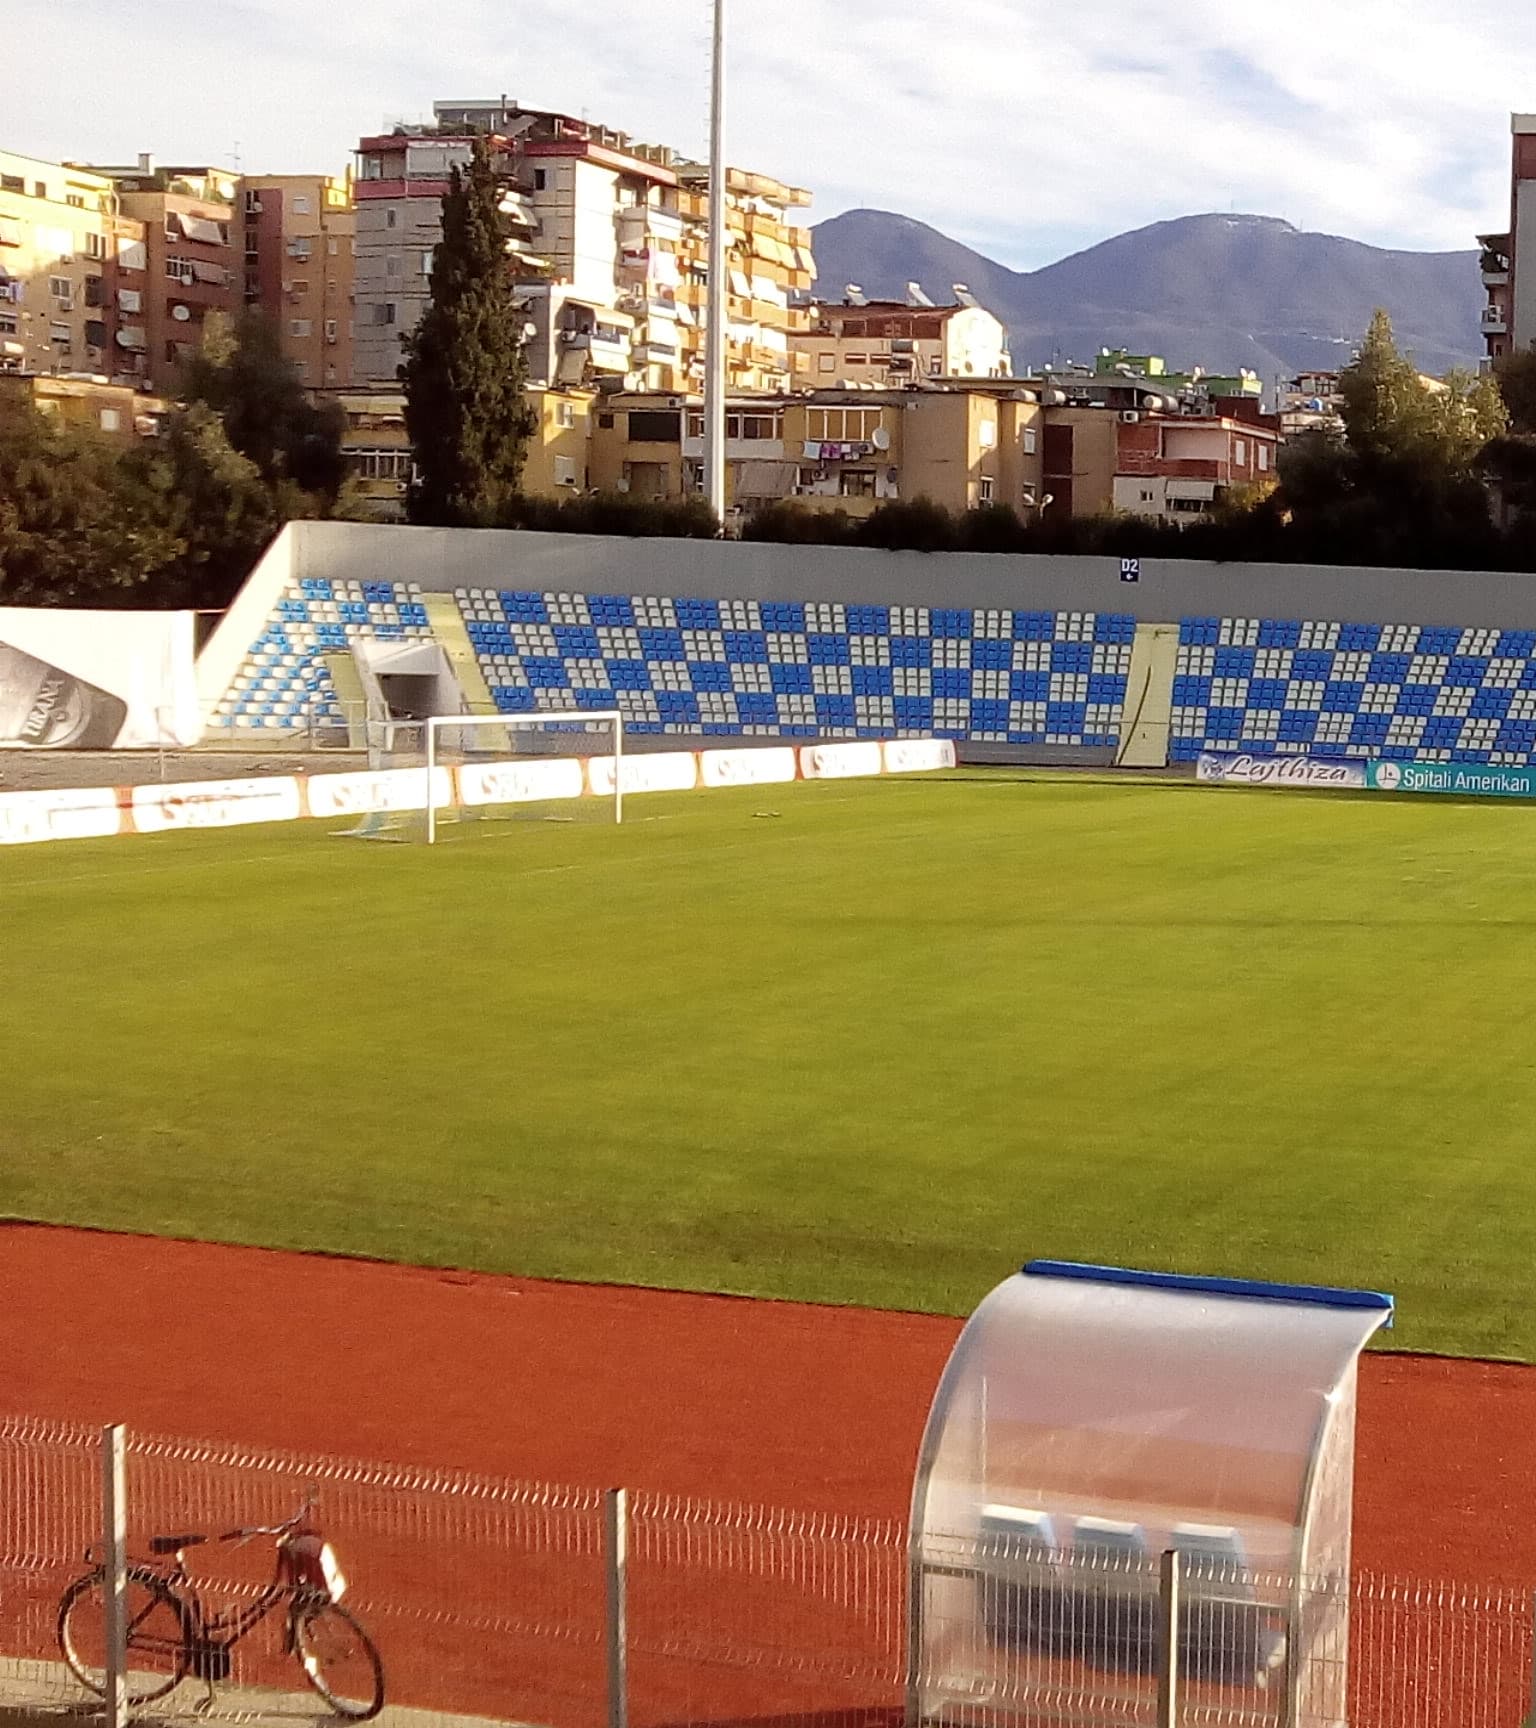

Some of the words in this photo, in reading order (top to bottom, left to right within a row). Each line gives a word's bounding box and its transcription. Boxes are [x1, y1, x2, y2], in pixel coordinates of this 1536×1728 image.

[1122, 559, 1138, 572] D2
[1225, 756, 1347, 782] Lajthiza
[1403, 767, 1452, 791] Spitali
[1456, 772, 1530, 792] Amerikan
